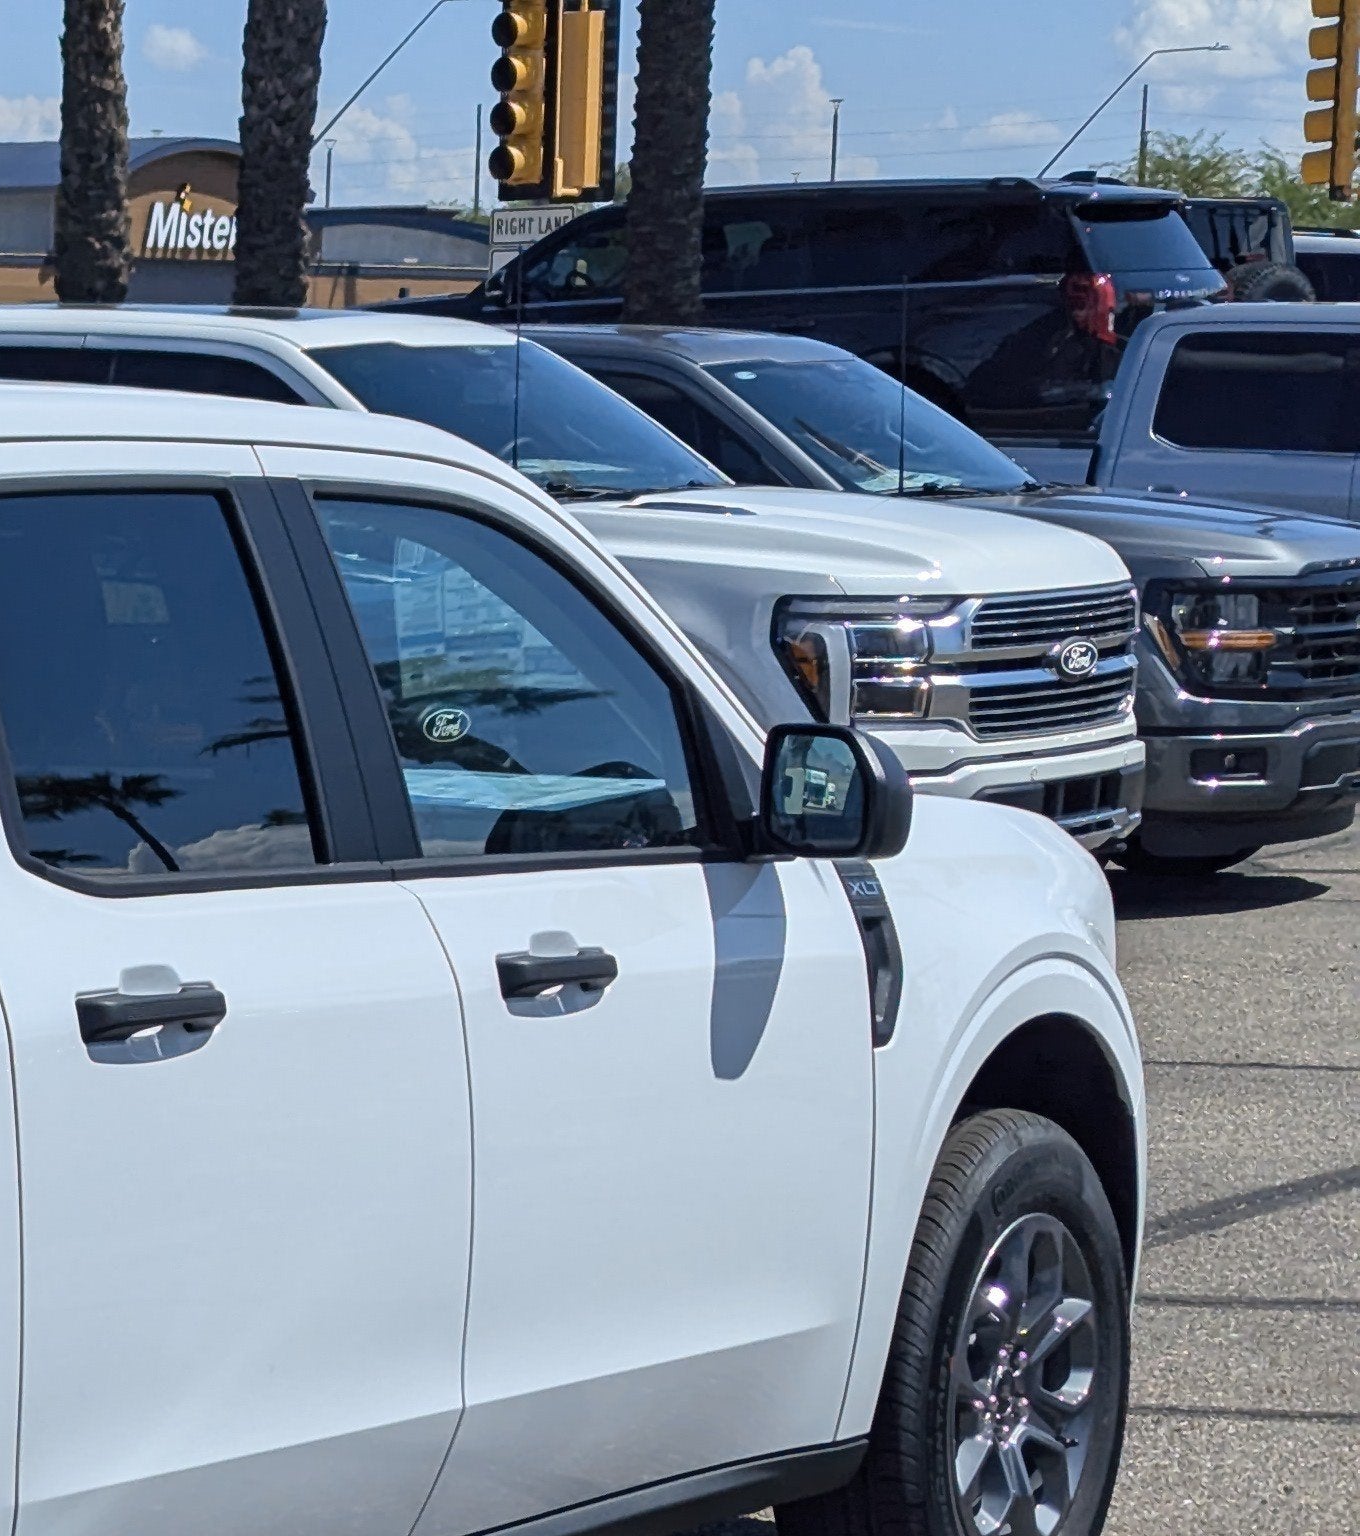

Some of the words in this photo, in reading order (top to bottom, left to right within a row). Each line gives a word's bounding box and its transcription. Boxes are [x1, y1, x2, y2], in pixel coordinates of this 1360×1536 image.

[496, 217, 534, 235] RIGHT
[1068, 646, 1092, 669] Ford
[432, 714, 462, 737] Ford
[847, 879, 880, 896] XLT
